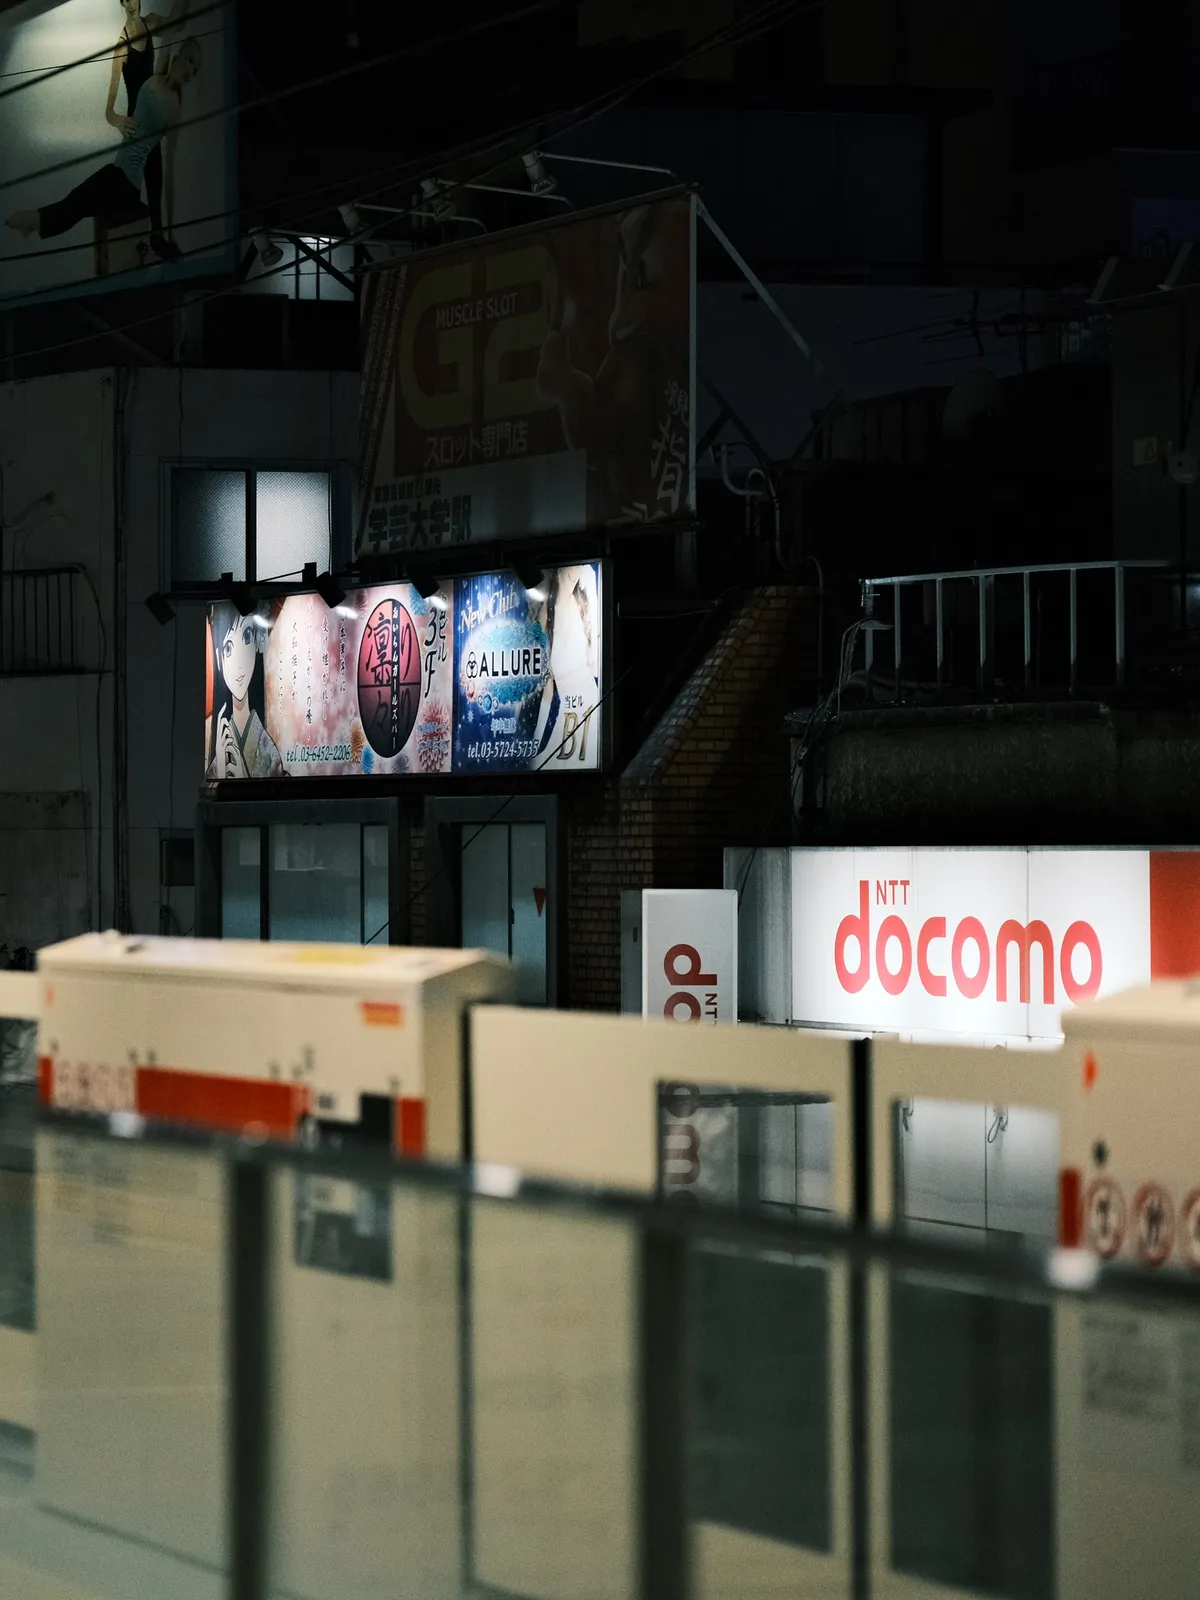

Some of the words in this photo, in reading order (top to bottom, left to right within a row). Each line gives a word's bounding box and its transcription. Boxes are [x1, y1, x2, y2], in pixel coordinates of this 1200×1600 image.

[435, 301, 483, 329] MUSCLE
[486, 292, 518, 320] SLOT
[424, 421, 529, 469] スロット専門店
[368, 494, 473, 553] 学芸大学駅
[460, 604, 486, 634] New
[487, 584, 519, 619] Club
[479, 648, 541, 678] ALLURE
[564, 694, 584, 709] 当ビル
[557, 705, 594, 762] B1
[876, 880, 910, 905] NTT
[834, 880, 1103, 1006] docomo
